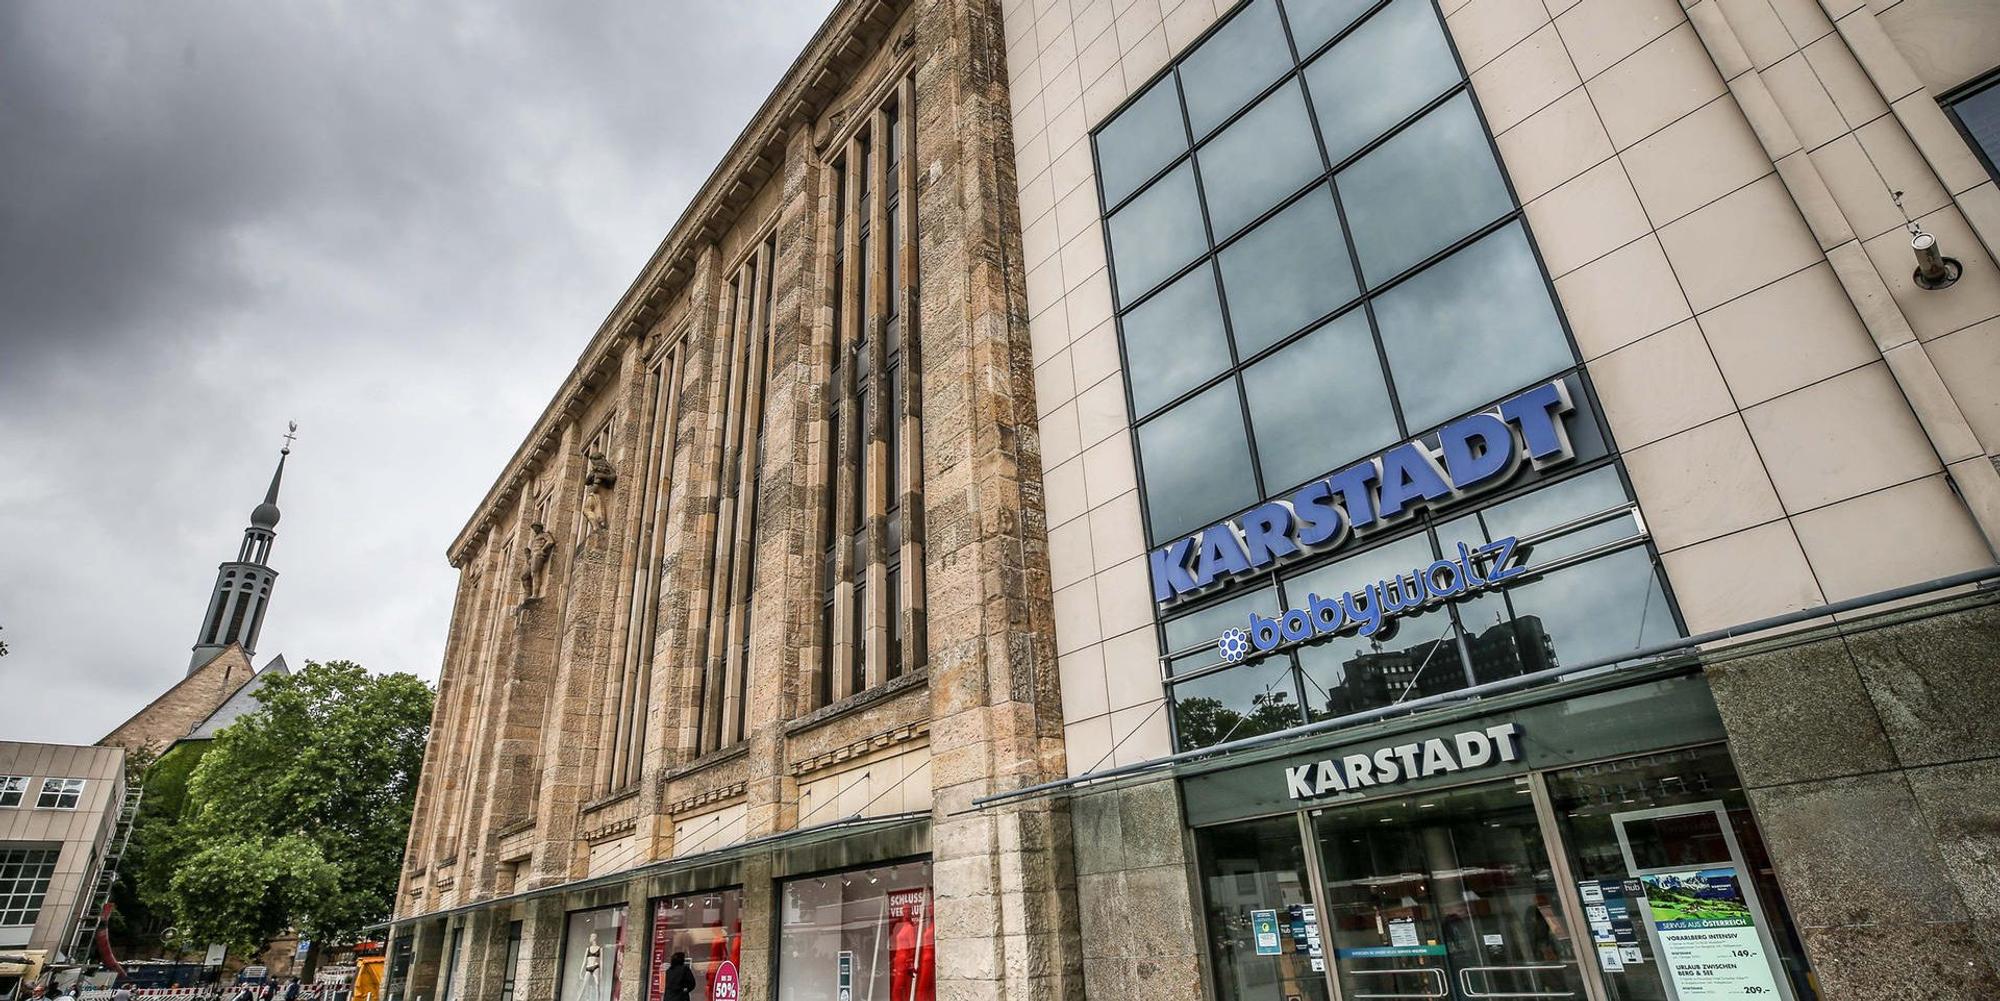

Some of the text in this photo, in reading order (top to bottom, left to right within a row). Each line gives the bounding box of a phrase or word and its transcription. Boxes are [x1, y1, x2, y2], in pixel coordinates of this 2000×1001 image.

[1150, 381, 1566, 604] KARSTADT
[1249, 535, 1527, 651] babywalz
[1285, 722, 1517, 800] KARSTADT
[1662, 918, 1747, 929] SERVUS AUS ÖSTERREICH
[715, 982, 736, 998] 50%
[1702, 969, 1714, 977] SEE
